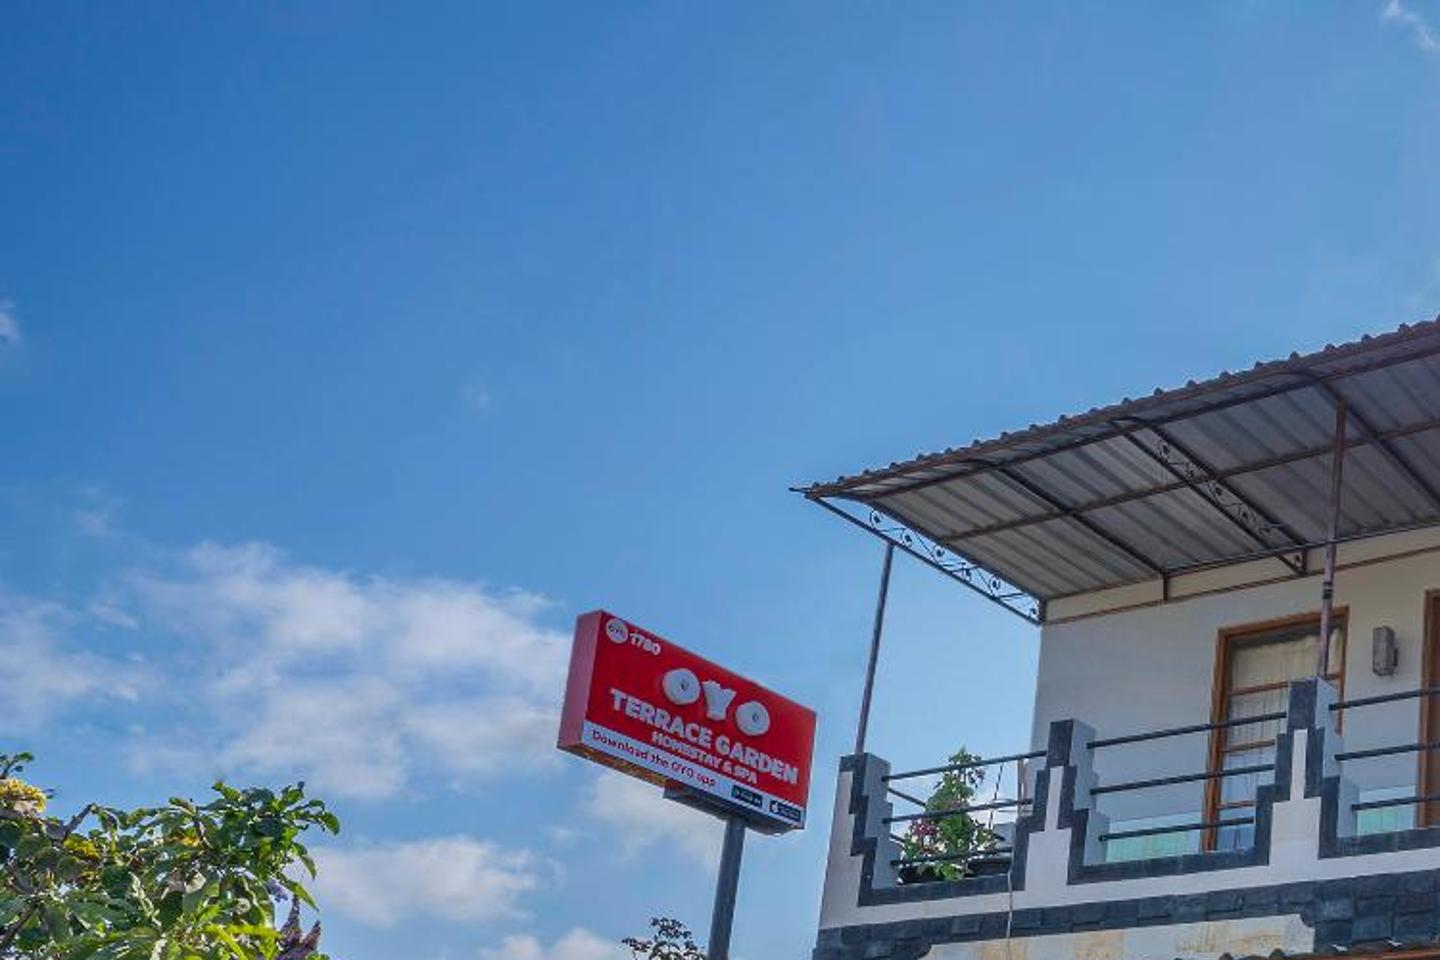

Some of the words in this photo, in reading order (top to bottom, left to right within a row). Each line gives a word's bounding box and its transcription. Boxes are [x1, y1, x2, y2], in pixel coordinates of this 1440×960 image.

[662, 667, 770, 736] OYO
[592, 729, 648, 760] Download
[650, 753, 669, 768] the
[671, 761, 694, 777] OYO
[610, 687, 712, 749] TERRACE
[715, 734, 799, 785] GARDEN
[652, 731, 722, 768] HOMESTAY
